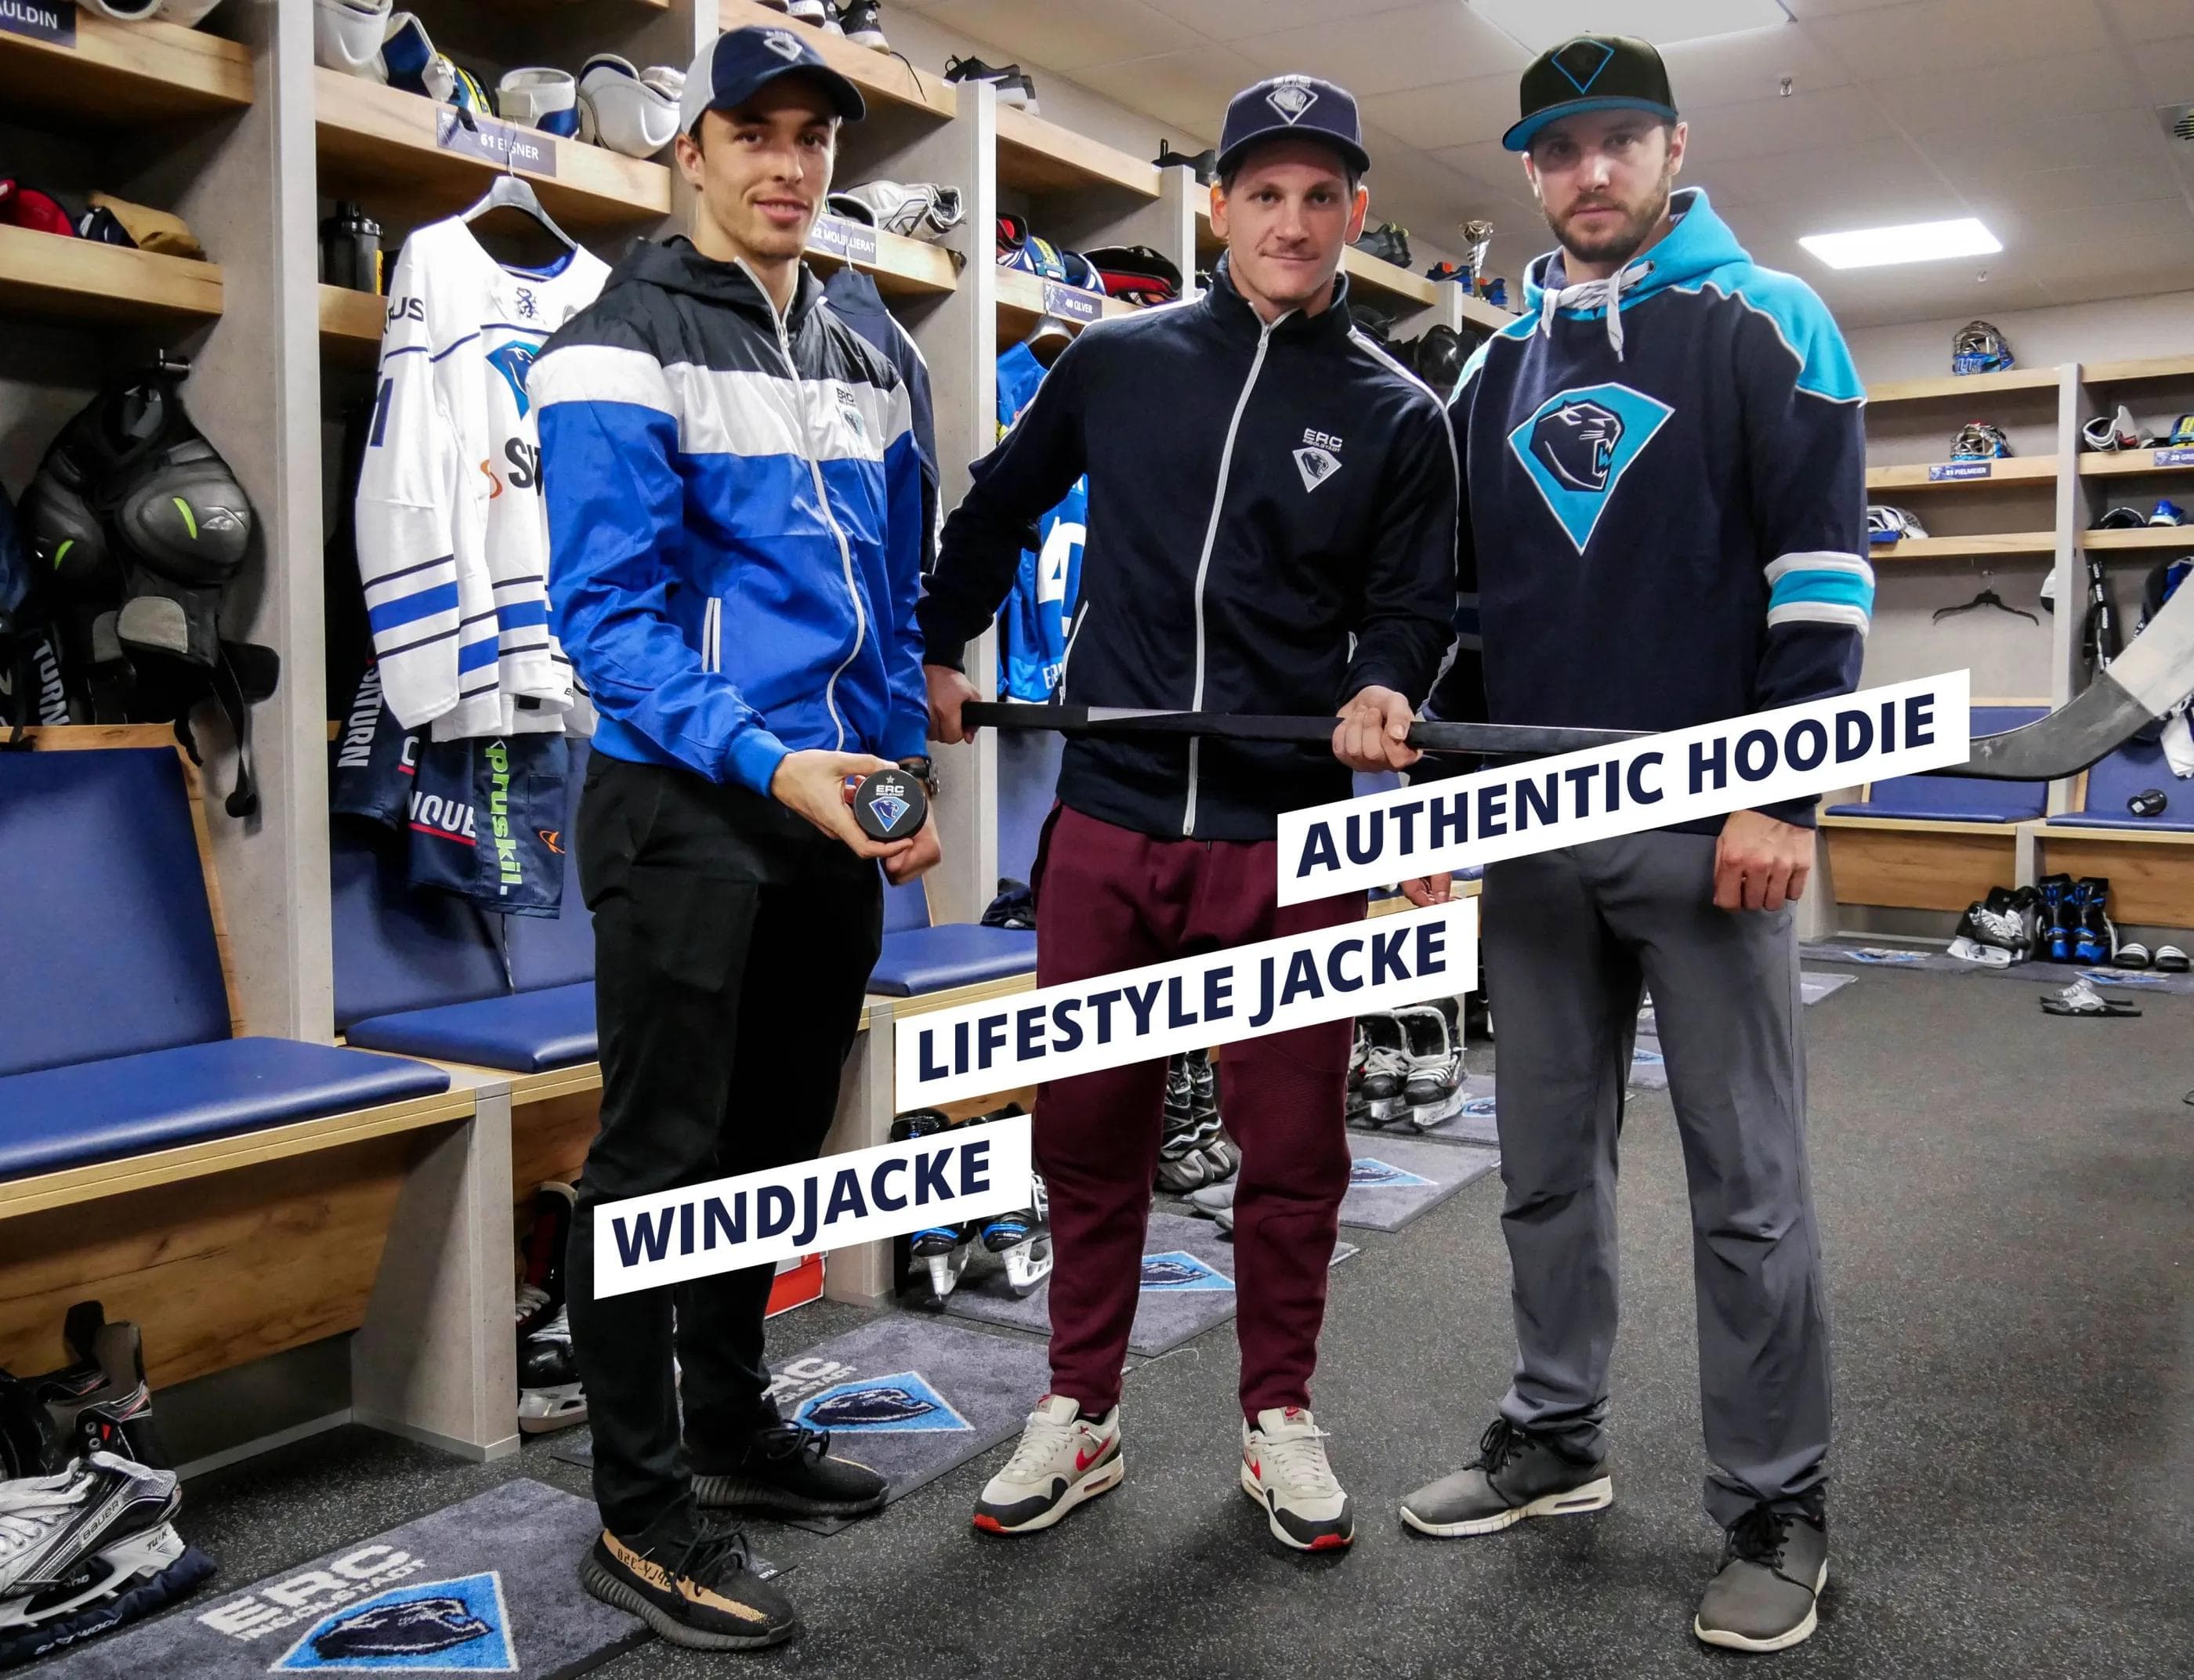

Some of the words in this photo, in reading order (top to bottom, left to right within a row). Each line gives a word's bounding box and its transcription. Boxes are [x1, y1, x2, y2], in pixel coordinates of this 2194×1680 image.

[1303, 427, 1343, 447] ERC
[875, 784, 905, 793] ERC
[760, 1357, 841, 1401] RC
[196, 1544, 411, 1635] ERC
